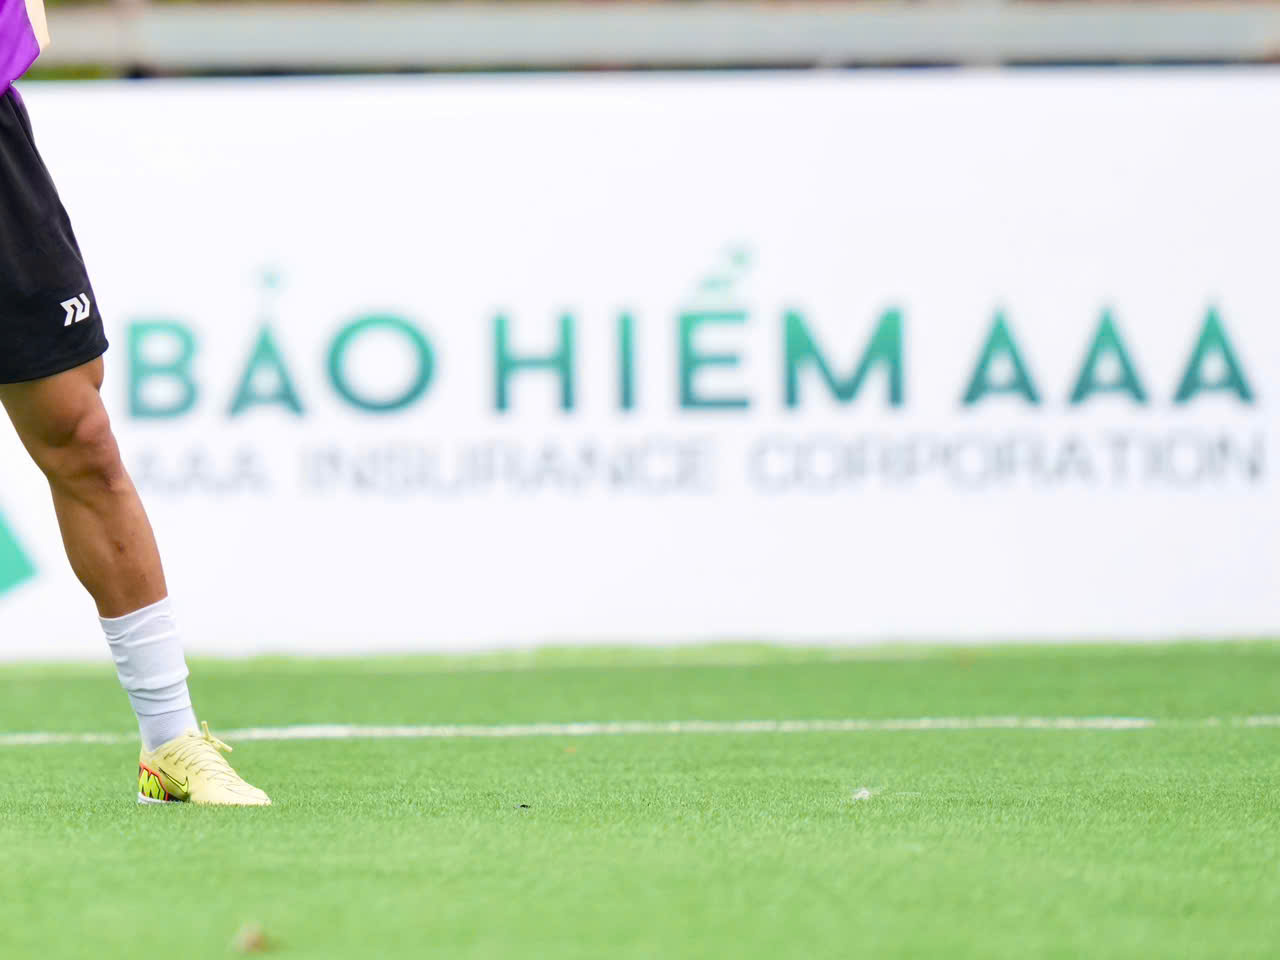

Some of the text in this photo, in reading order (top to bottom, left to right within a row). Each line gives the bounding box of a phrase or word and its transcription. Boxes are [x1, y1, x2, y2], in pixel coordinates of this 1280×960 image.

[125, 248, 1256, 418] BẢO HIỂM AAA
[300, 437, 716, 496] INSURANCE
[748, 428, 1266, 494] CORPORATION
